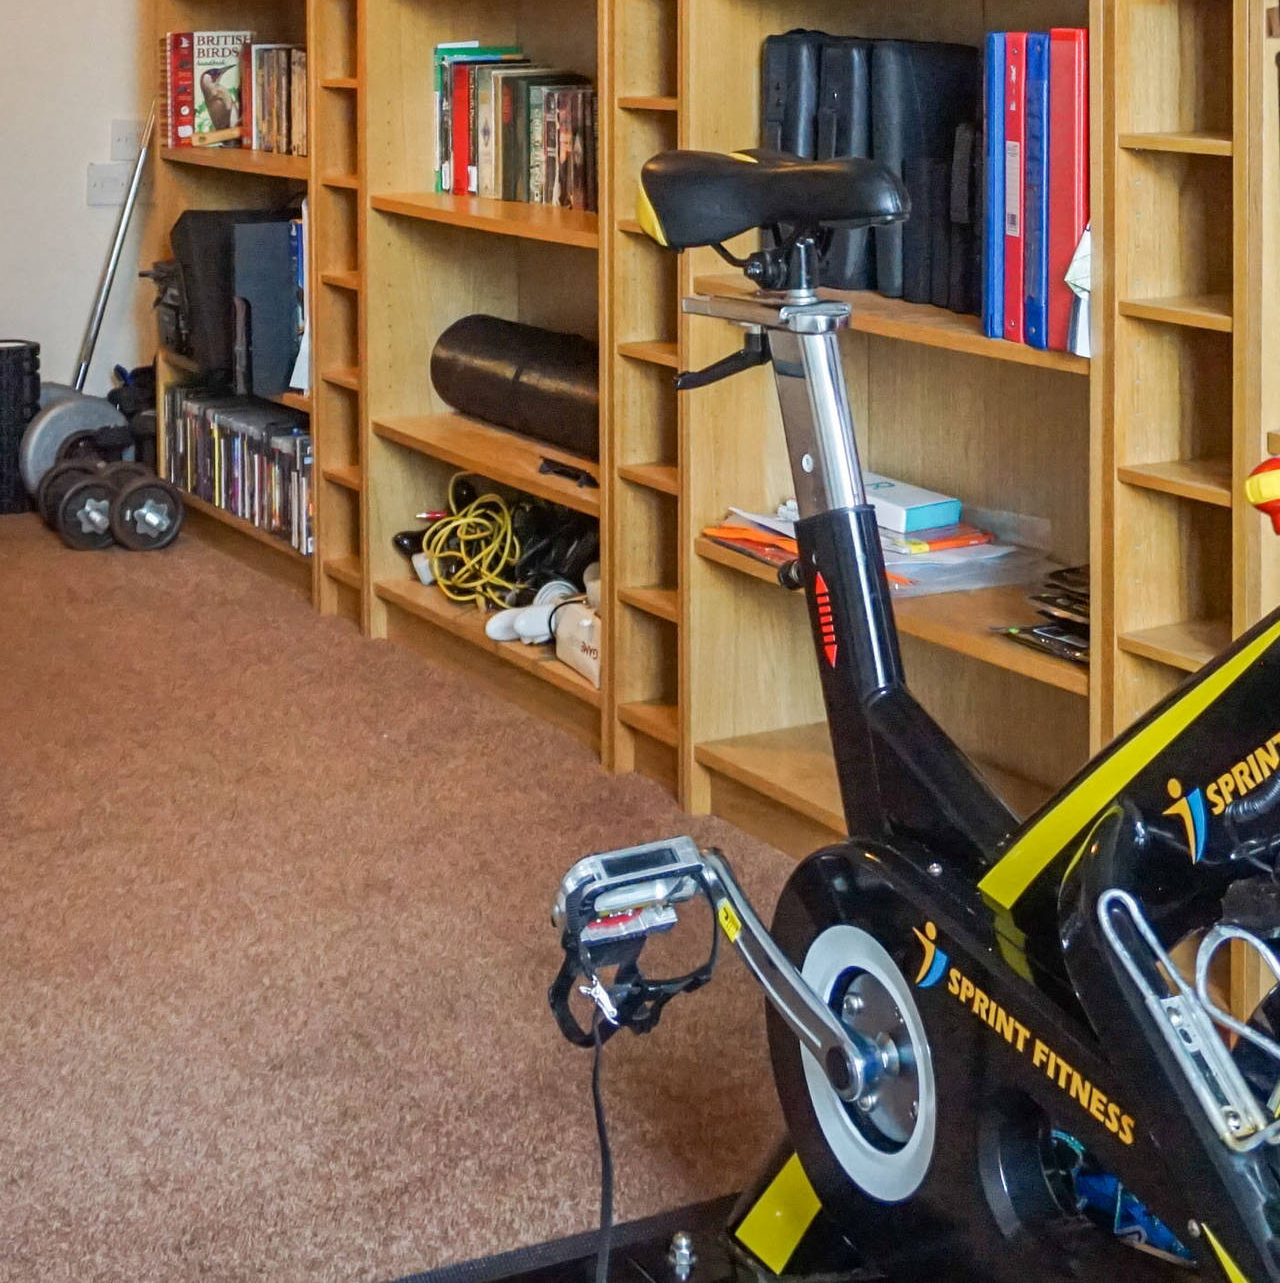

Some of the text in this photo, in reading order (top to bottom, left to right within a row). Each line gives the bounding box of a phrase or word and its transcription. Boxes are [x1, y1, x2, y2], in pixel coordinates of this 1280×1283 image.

[196, 35, 251, 46] BRITISH
[197, 47, 240, 59] BIRDS
[581, 641, 599, 660] GAME
[947, 968, 1135, 1145] SPRINT FITNESS
